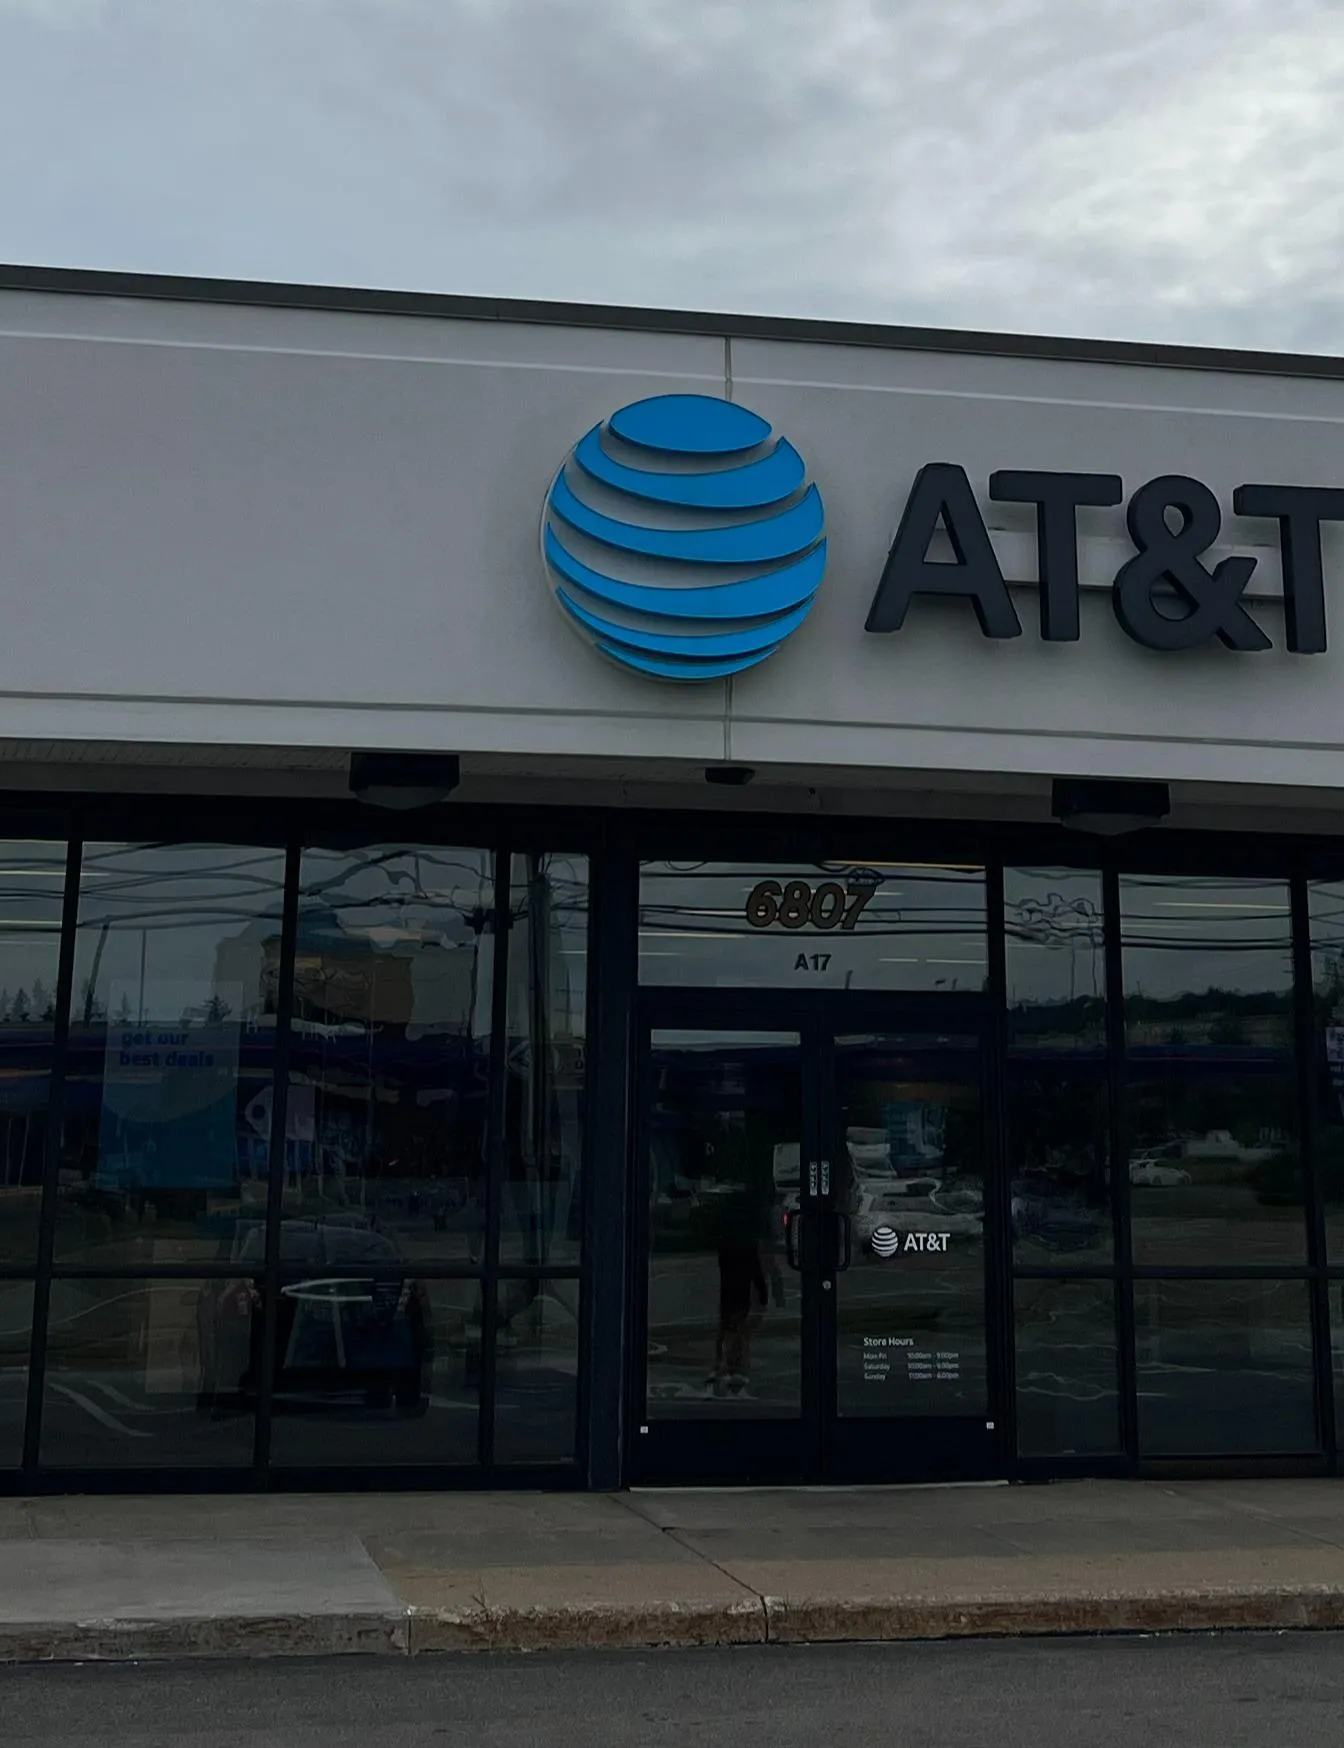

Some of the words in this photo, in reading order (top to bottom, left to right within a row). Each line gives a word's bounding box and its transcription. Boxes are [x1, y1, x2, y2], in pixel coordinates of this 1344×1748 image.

[745, 879, 876, 929] 6807
[795, 953, 832, 971] A17
[121, 1030, 153, 1049] get
[156, 1032, 189, 1046] our
[119, 1050, 159, 1066] best
[164, 1050, 215, 1067] deals
[903, 1232, 951, 1252] AT&T
[863, 1336, 887, 1346] Store
[888, 1336, 915, 1347] Hours
